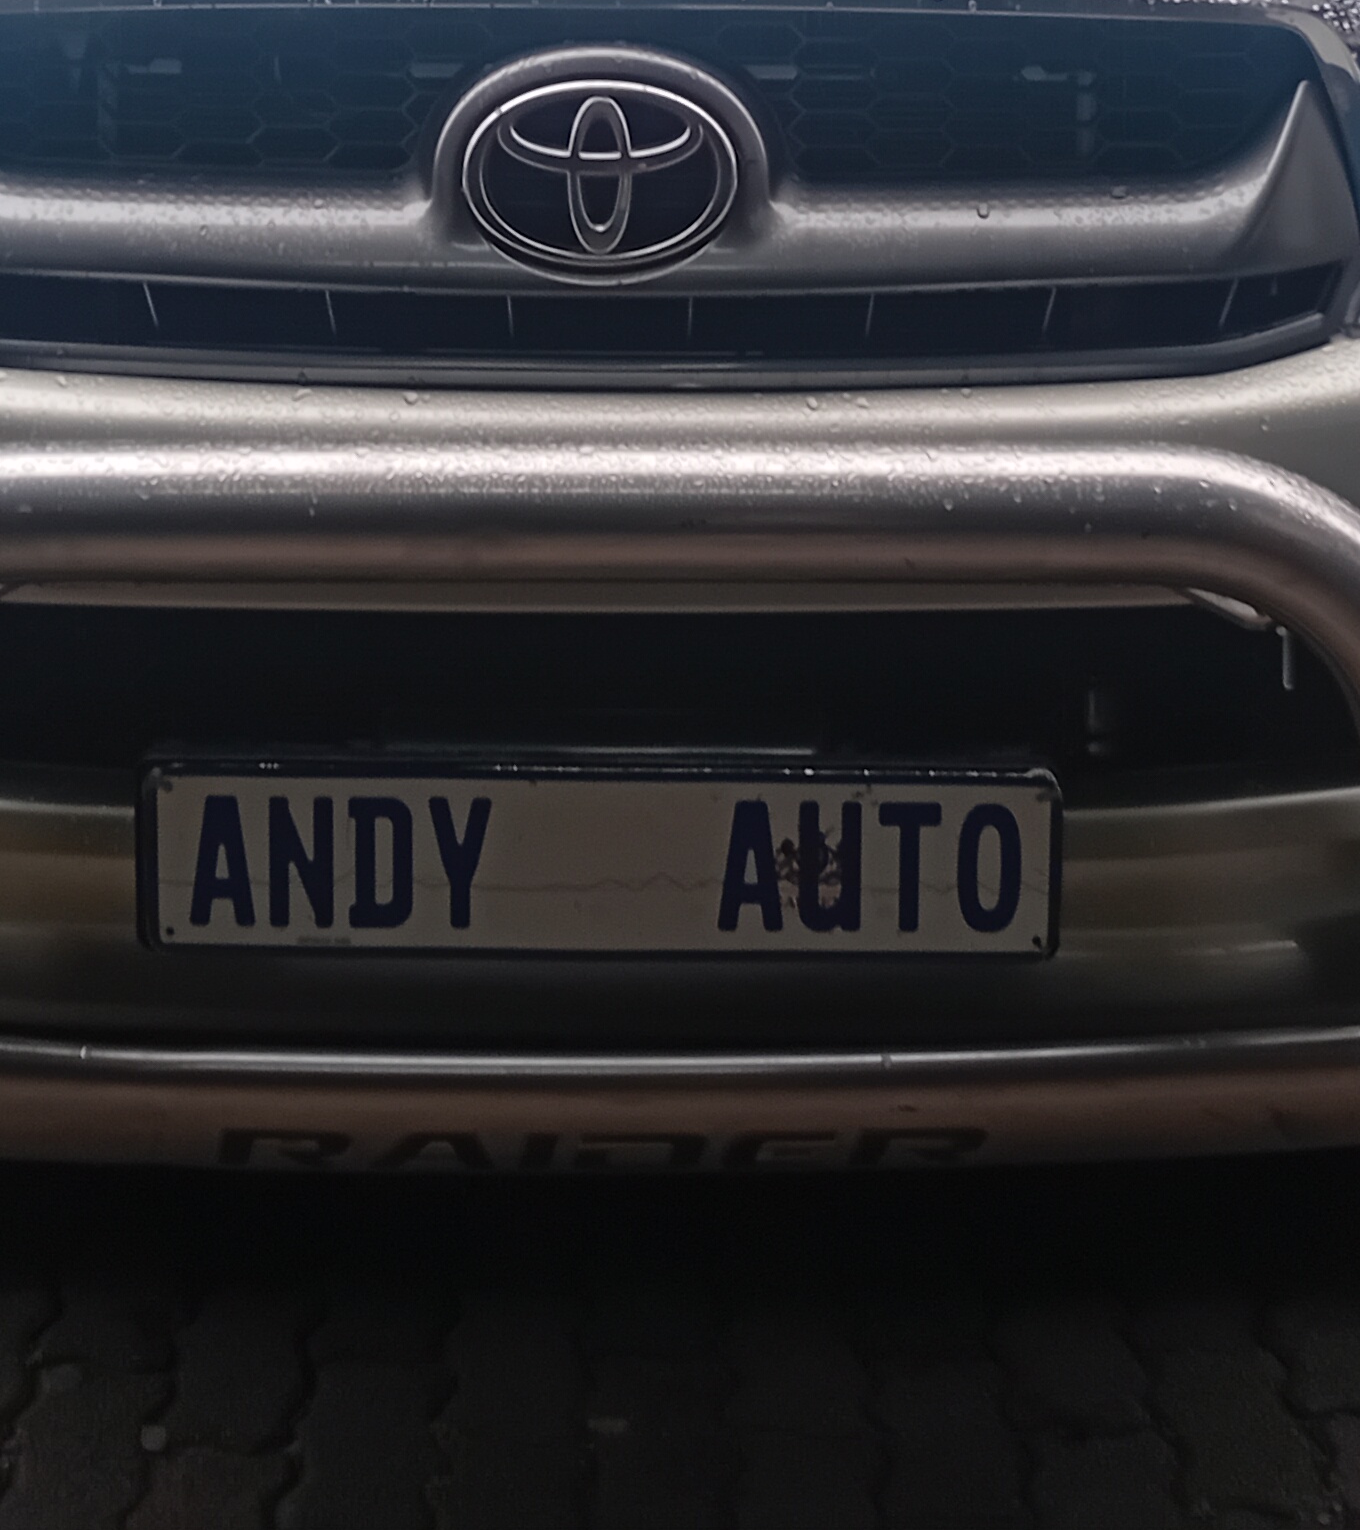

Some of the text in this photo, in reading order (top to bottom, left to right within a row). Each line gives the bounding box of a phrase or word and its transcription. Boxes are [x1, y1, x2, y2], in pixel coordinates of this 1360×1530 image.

[190, 795, 1025, 934] ANDY AUTO
[216, 1126, 992, 1174] RAIDER
